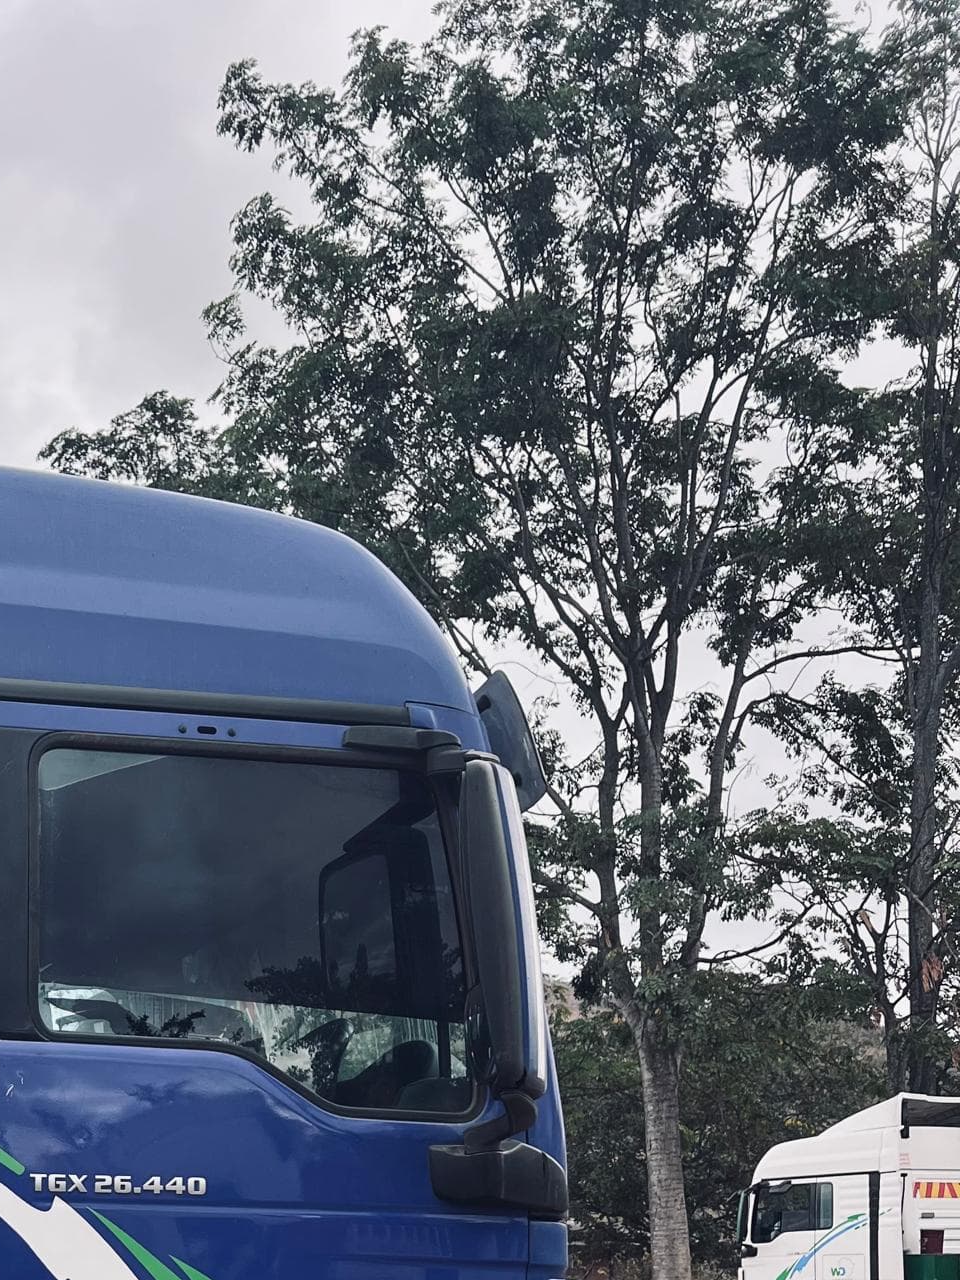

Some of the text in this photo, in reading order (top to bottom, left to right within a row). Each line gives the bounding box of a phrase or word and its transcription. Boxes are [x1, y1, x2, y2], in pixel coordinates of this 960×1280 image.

[29, 1173, 207, 1196] TGX 26.440
[830, 1266, 846, 1277] WD
